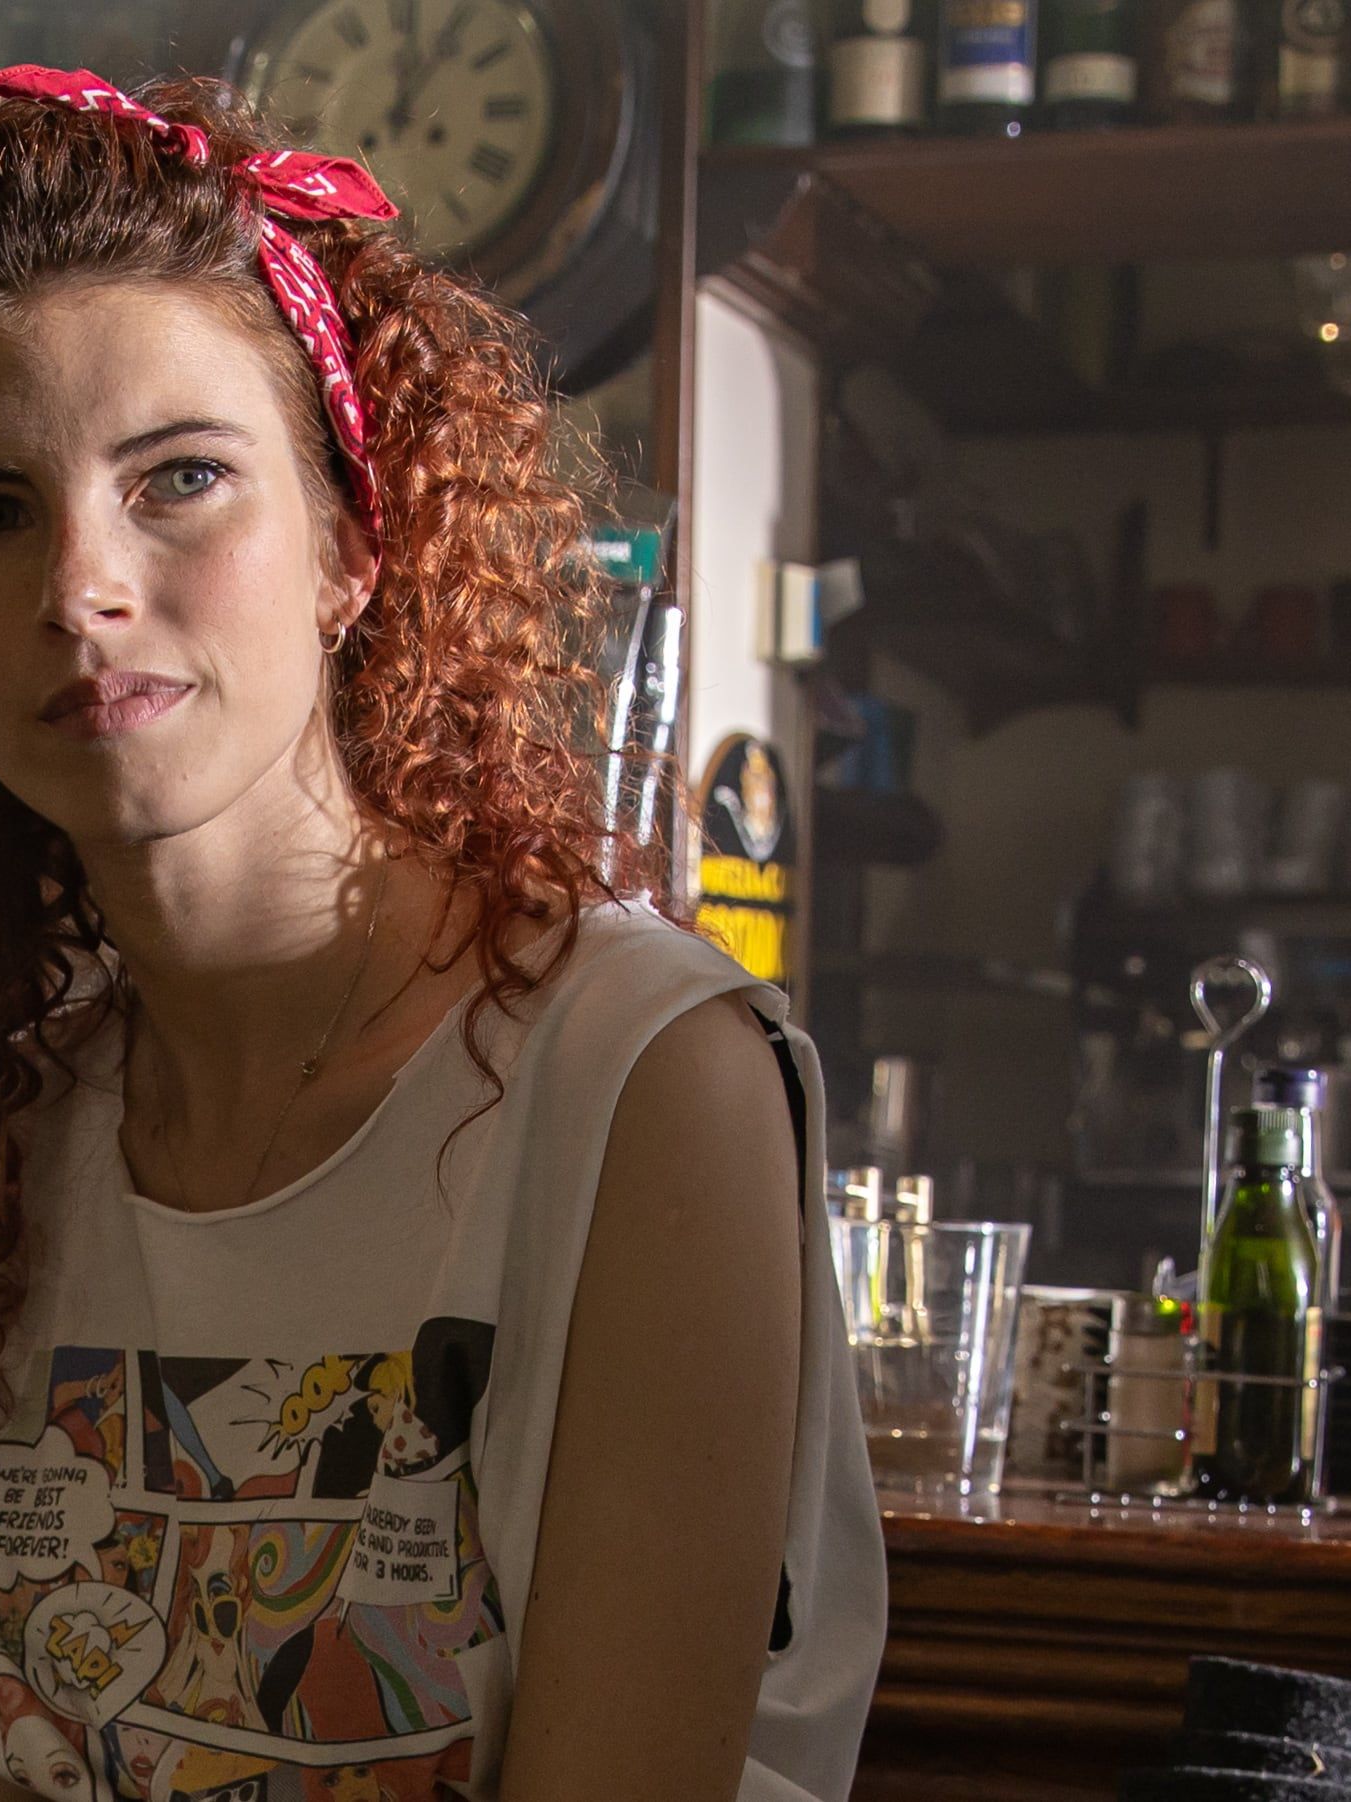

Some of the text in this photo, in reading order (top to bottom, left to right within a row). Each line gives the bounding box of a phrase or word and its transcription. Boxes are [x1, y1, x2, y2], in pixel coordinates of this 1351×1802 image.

[43, 1466, 88, 1485] GONNA
[4, 1486, 66, 1508] BE BEST
[368, 1533, 393, 1554] AND
[375, 1559, 386, 1579] 3
[391, 1563, 433, 1582] HOURS.
[44, 1615, 124, 1701] ZAP!
